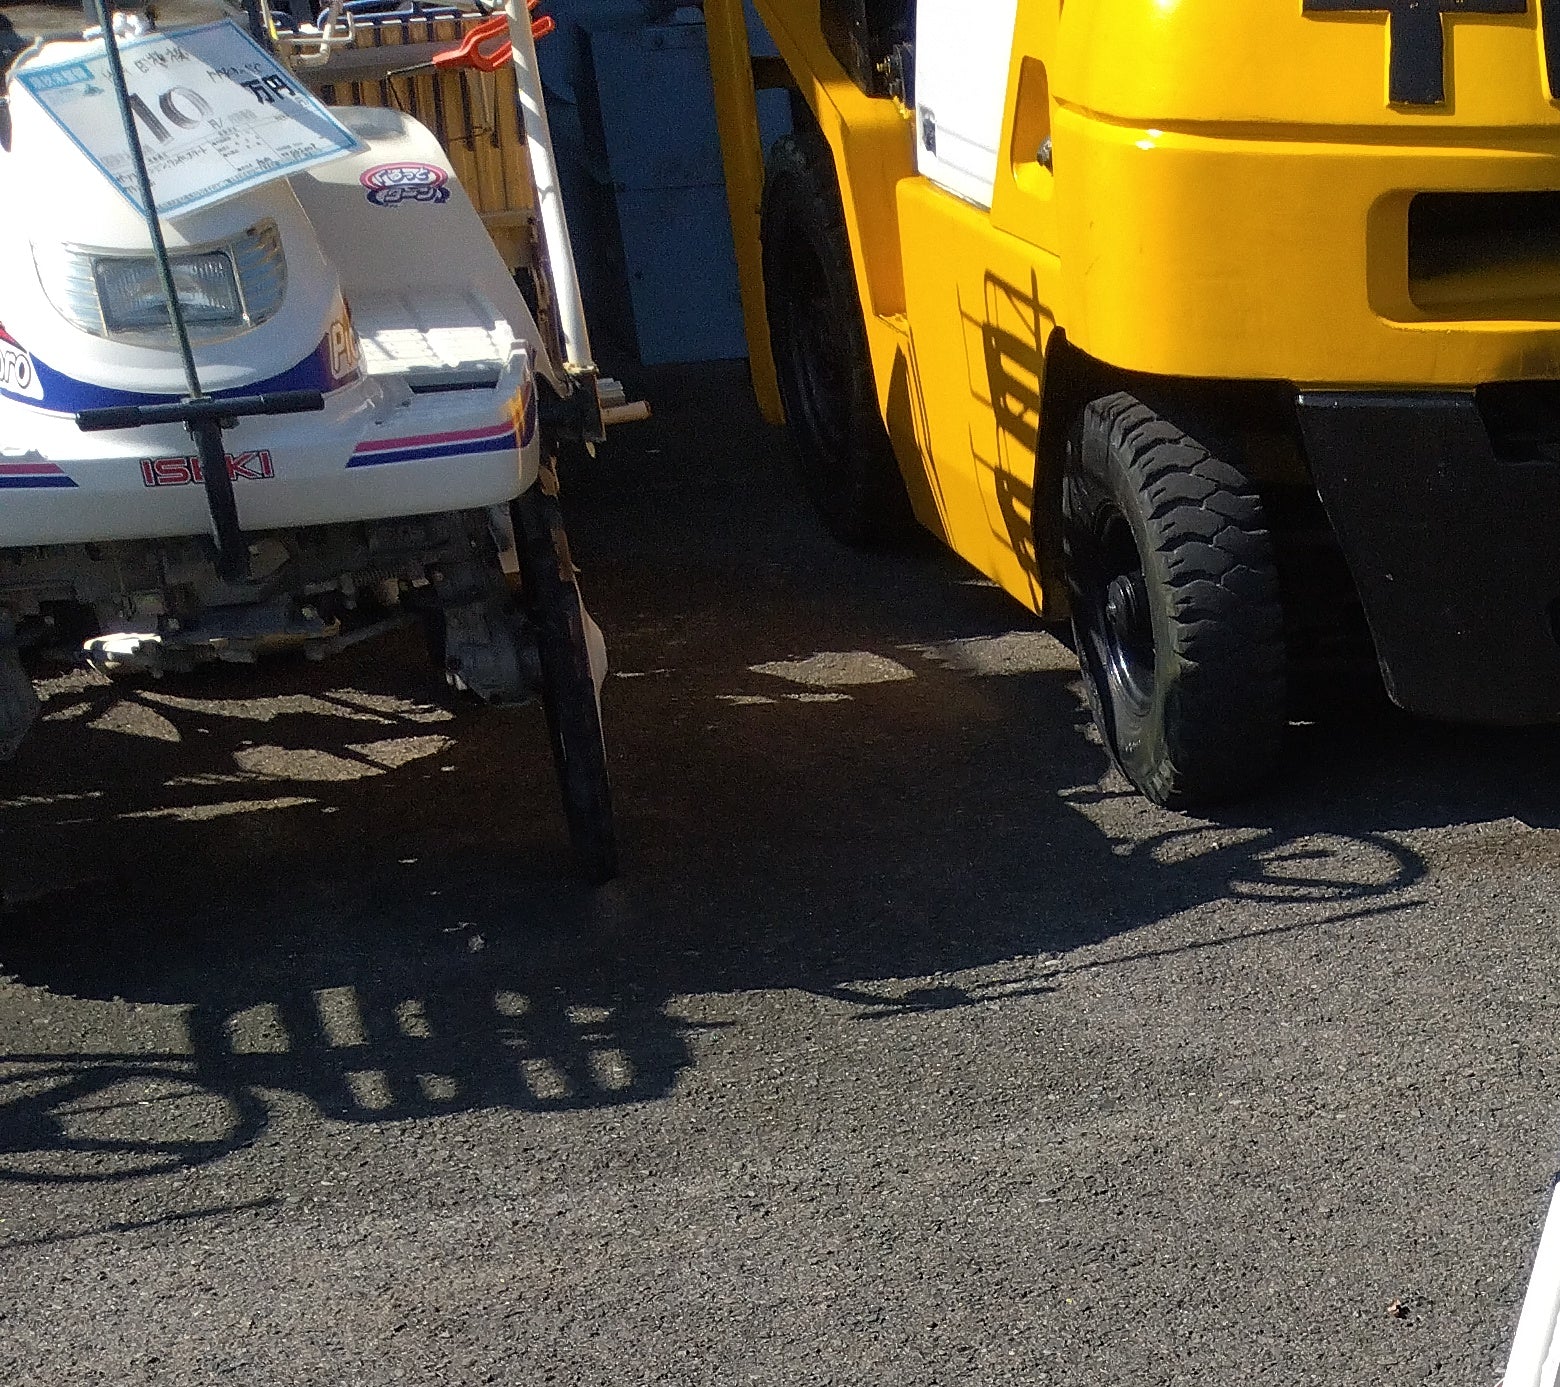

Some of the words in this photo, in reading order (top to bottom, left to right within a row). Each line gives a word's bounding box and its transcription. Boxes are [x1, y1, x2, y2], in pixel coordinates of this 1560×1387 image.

[240, 74, 296, 104] 万円
[129, 86, 214, 144] 10
[0, 350, 32, 389] ro
